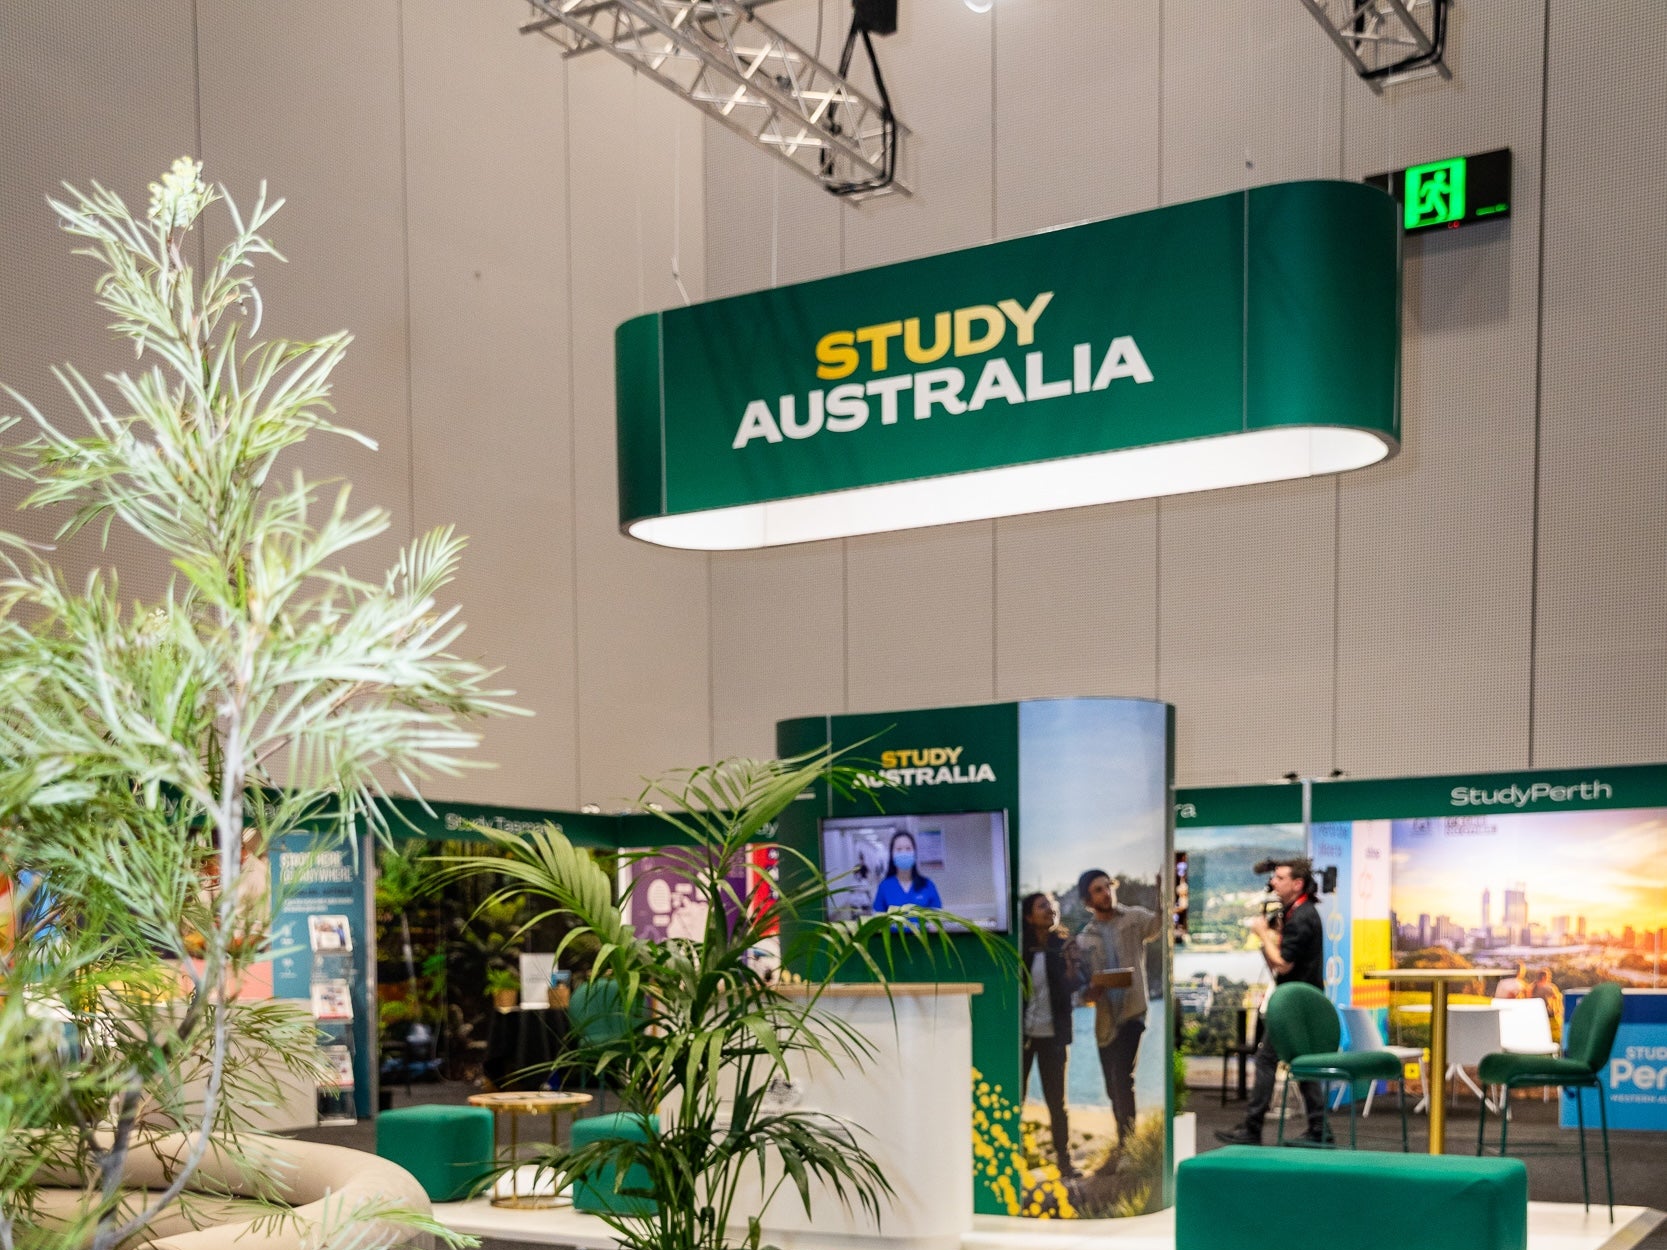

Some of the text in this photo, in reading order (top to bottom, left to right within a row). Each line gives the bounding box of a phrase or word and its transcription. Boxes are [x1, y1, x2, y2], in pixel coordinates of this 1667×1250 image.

[815, 291, 1055, 380] STUDY
[731, 335, 1154, 450] AUSTRALIA
[881, 746, 964, 769] STUDY
[851, 763, 997, 789] AUSTRALIA
[1450, 779, 1613, 808] StudyPerth
